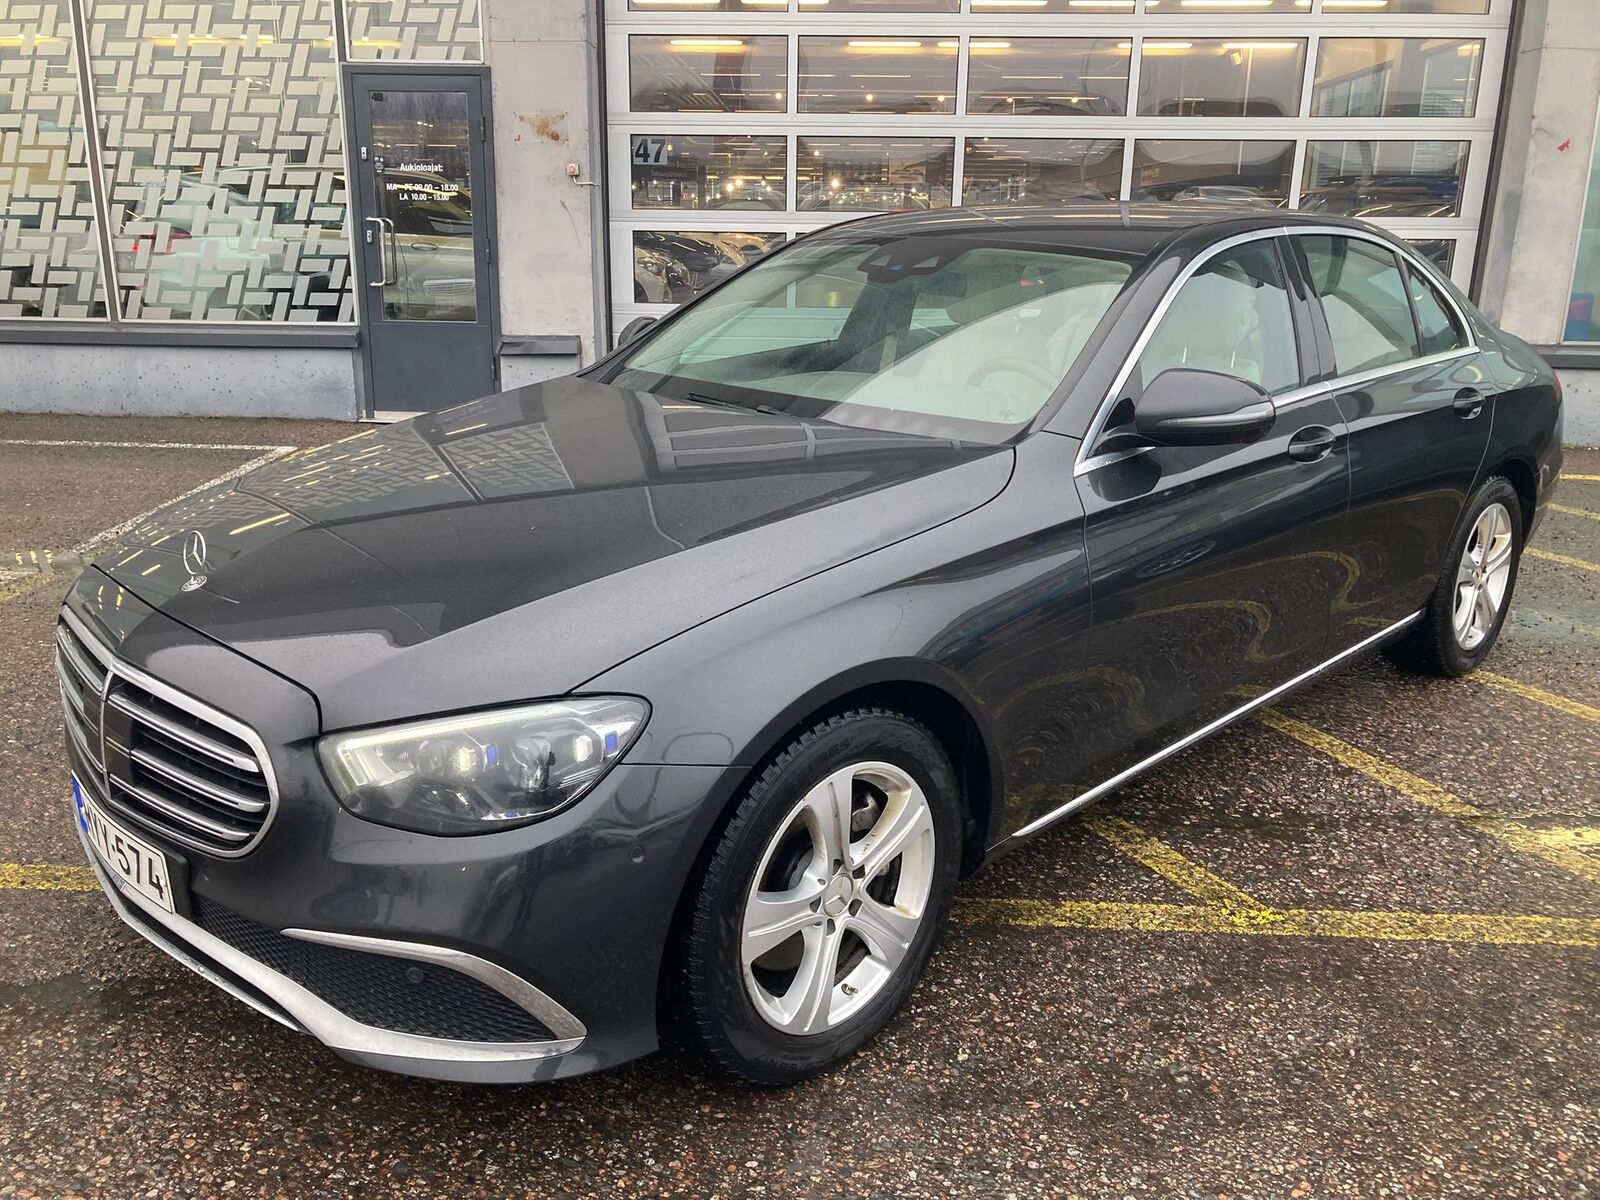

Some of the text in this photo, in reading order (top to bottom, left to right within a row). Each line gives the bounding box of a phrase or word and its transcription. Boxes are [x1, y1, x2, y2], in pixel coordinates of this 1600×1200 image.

[634, 138, 666, 163] 47
[399, 163, 443, 173] Aukioloajat:
[386, 183, 398, 191] MA
[433, 193, 450, 201] 15.00
